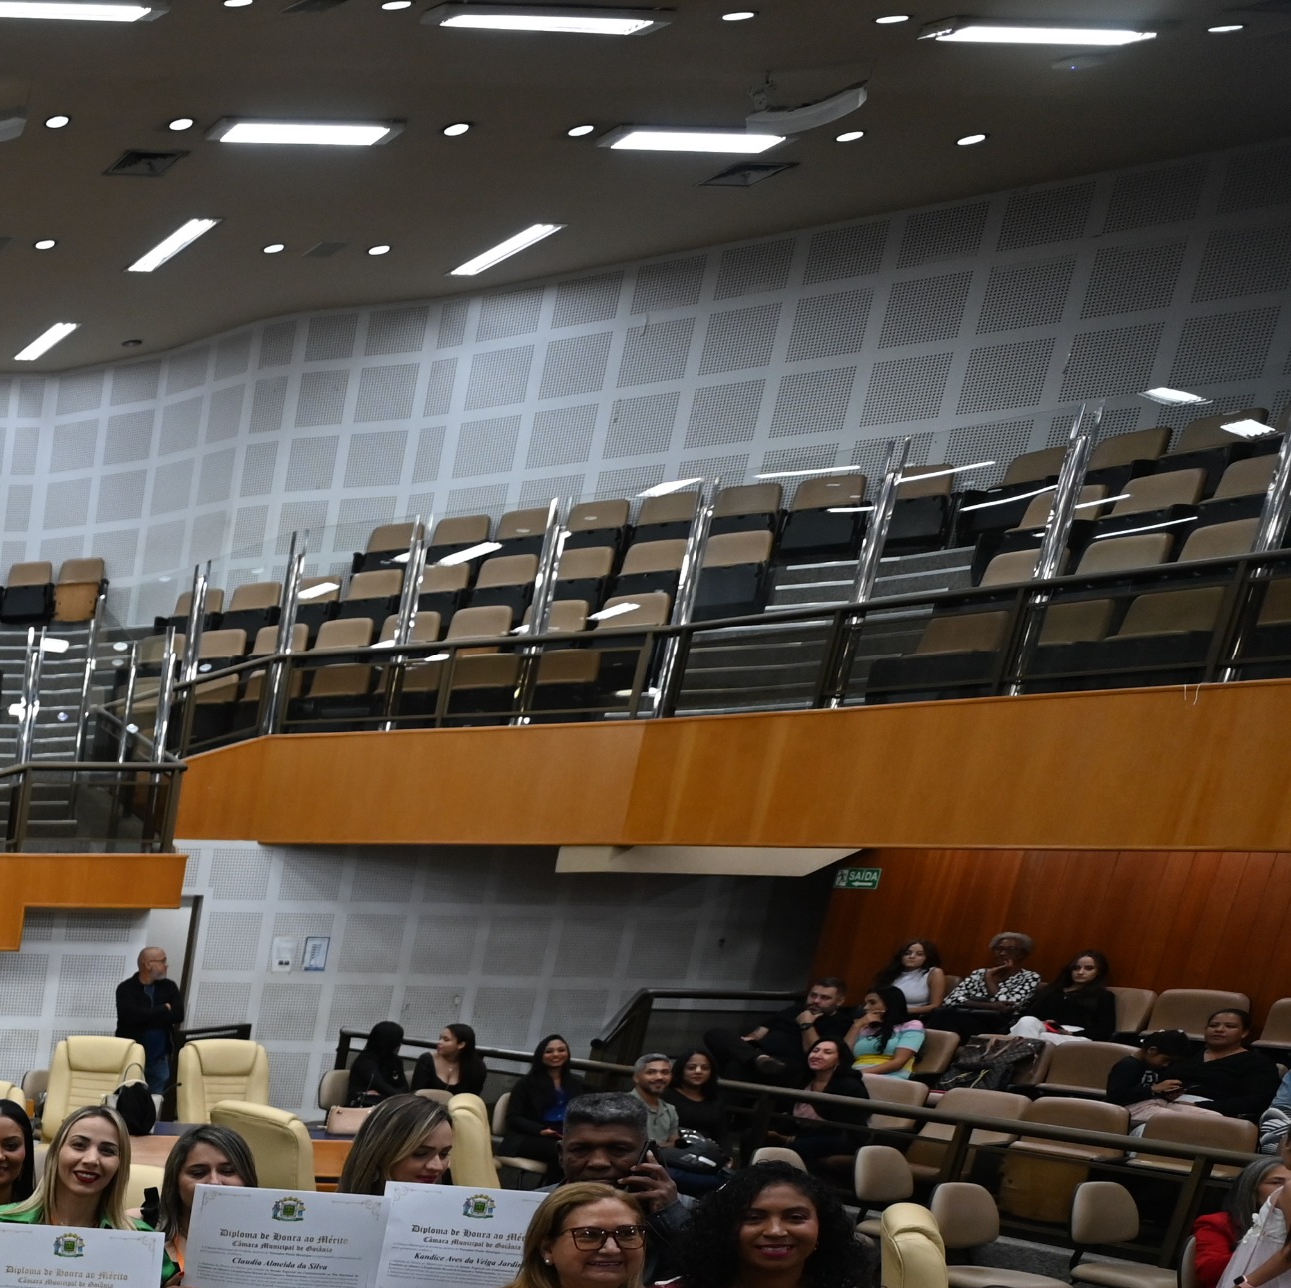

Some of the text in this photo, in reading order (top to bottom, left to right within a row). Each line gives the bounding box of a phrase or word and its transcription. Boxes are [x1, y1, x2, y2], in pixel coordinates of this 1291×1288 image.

[849, 870, 878, 881] SAÍDA
[232, 1257, 328, 1271] Claudia Almeida da Silva
[414, 1252, 445, 1262] Kandice
[464, 1257, 475, 1265] da
[476, 1257, 497, 1267] Veiga
